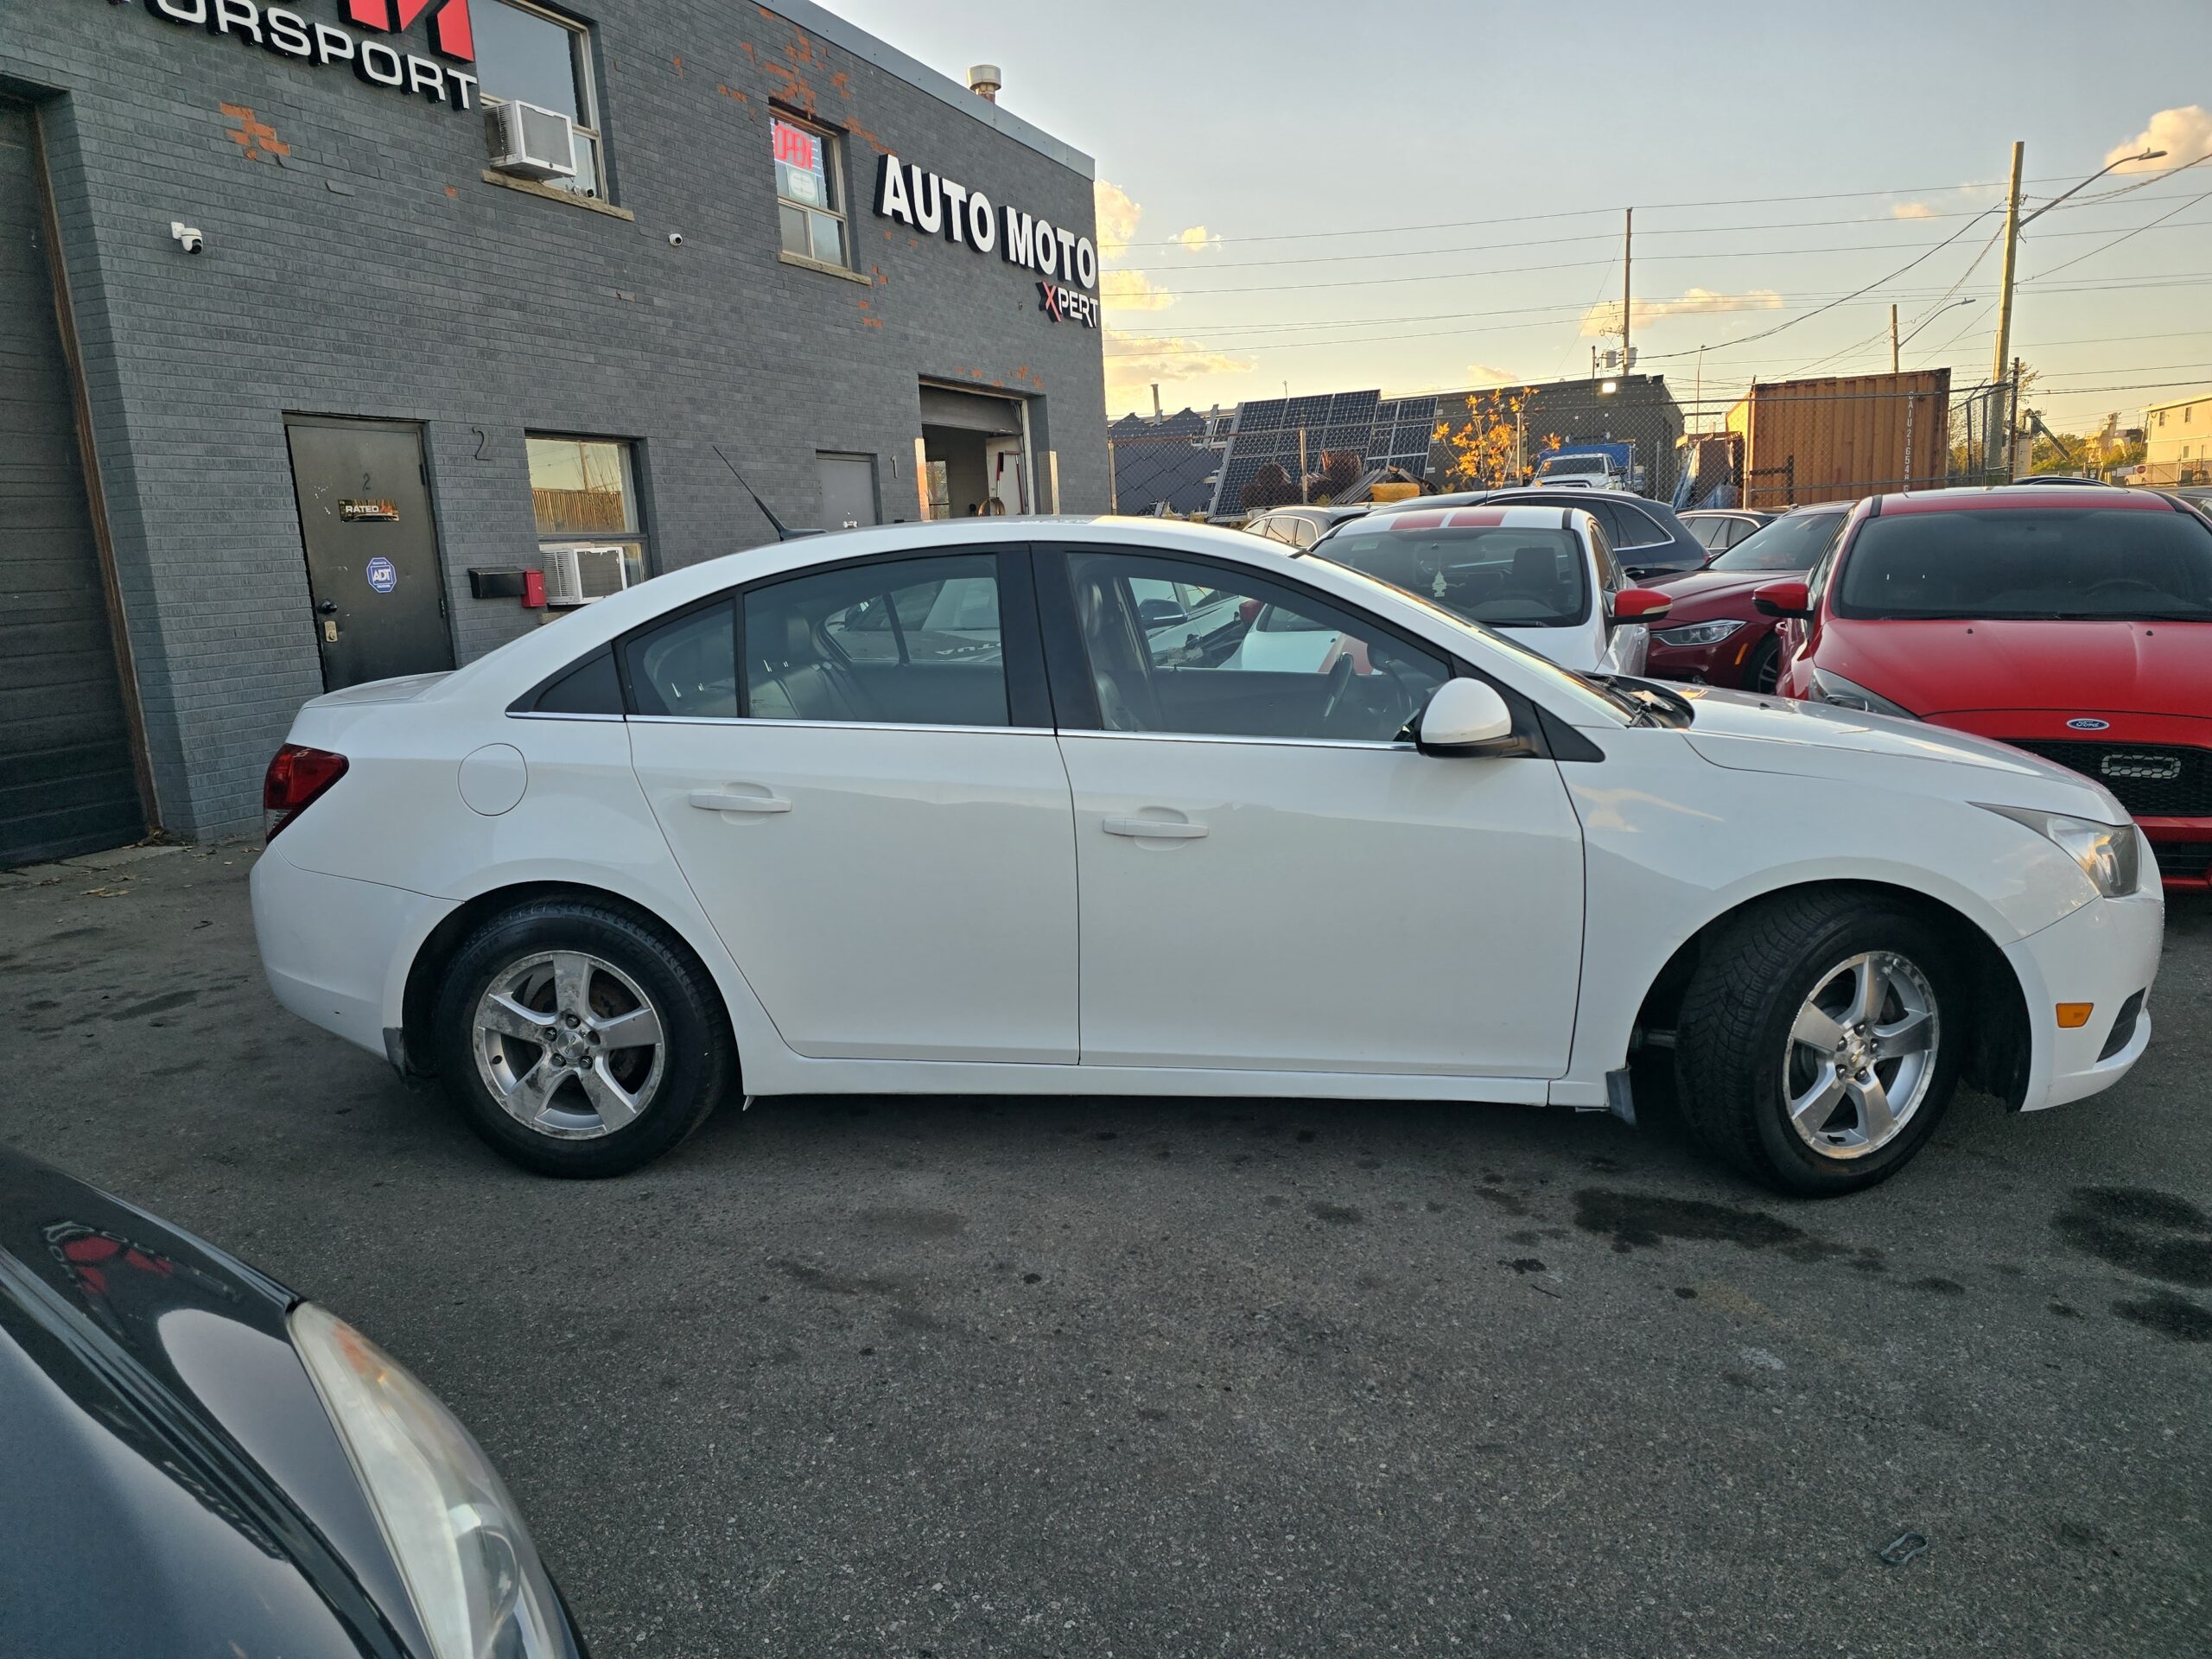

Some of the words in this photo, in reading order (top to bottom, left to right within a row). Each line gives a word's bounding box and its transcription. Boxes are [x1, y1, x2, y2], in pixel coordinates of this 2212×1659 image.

[156, 0, 478, 110] ORSPORT
[774, 124, 813, 171] OPEN
[879, 153, 995, 253] AUTO
[1004, 205, 1096, 289] MOTO
[1040, 281, 1099, 329] XPERT
[471, 427, 493, 461] 2
[362, 473, 372, 492] 2
[890, 454, 899, 479] 1
[345, 505, 379, 513] RATED
[372, 568, 391, 582] ADT
